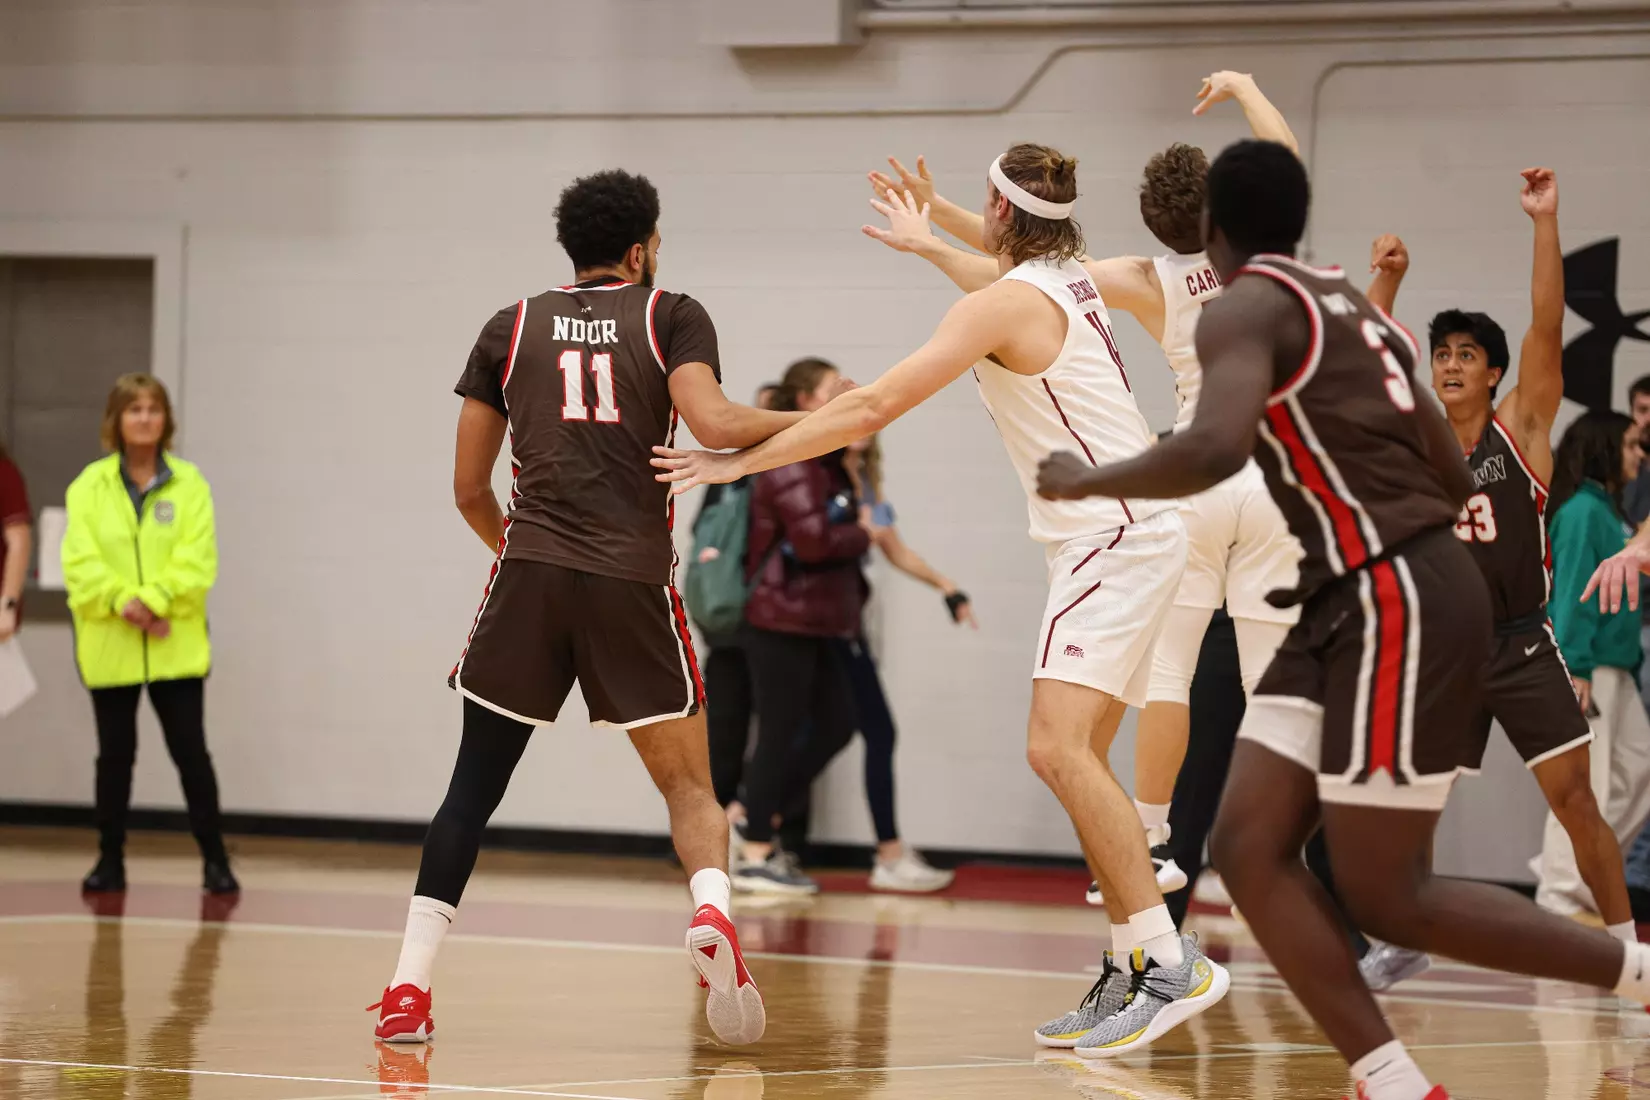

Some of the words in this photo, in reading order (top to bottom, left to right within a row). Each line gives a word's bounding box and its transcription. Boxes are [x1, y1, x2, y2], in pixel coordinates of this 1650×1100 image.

[552, 315, 619, 345] NDUR
[1360, 318, 1416, 413] 3
[558, 349, 620, 423] 11
